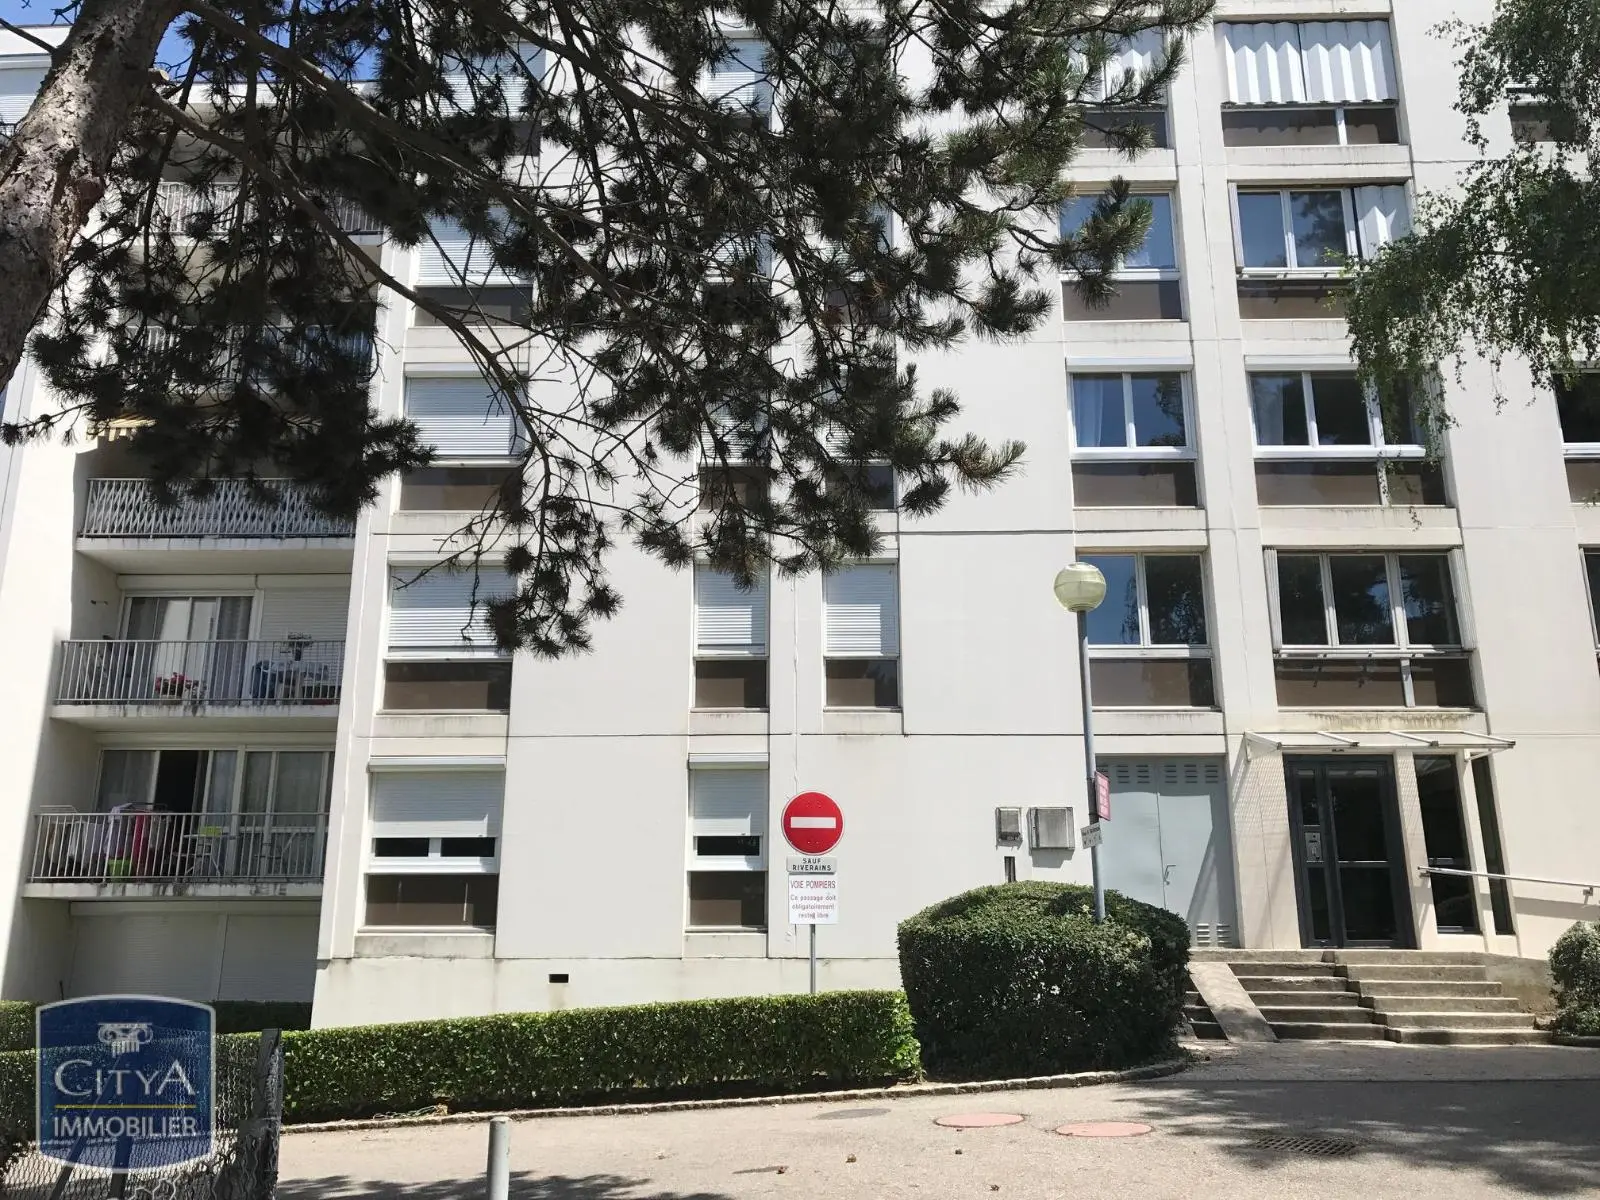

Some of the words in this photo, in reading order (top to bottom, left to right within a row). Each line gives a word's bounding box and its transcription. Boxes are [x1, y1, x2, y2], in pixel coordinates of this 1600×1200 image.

[790, 880, 804, 889] VOIE
[806, 880, 836, 889] POMPIERS
[792, 903, 835, 911] obligatoirement
